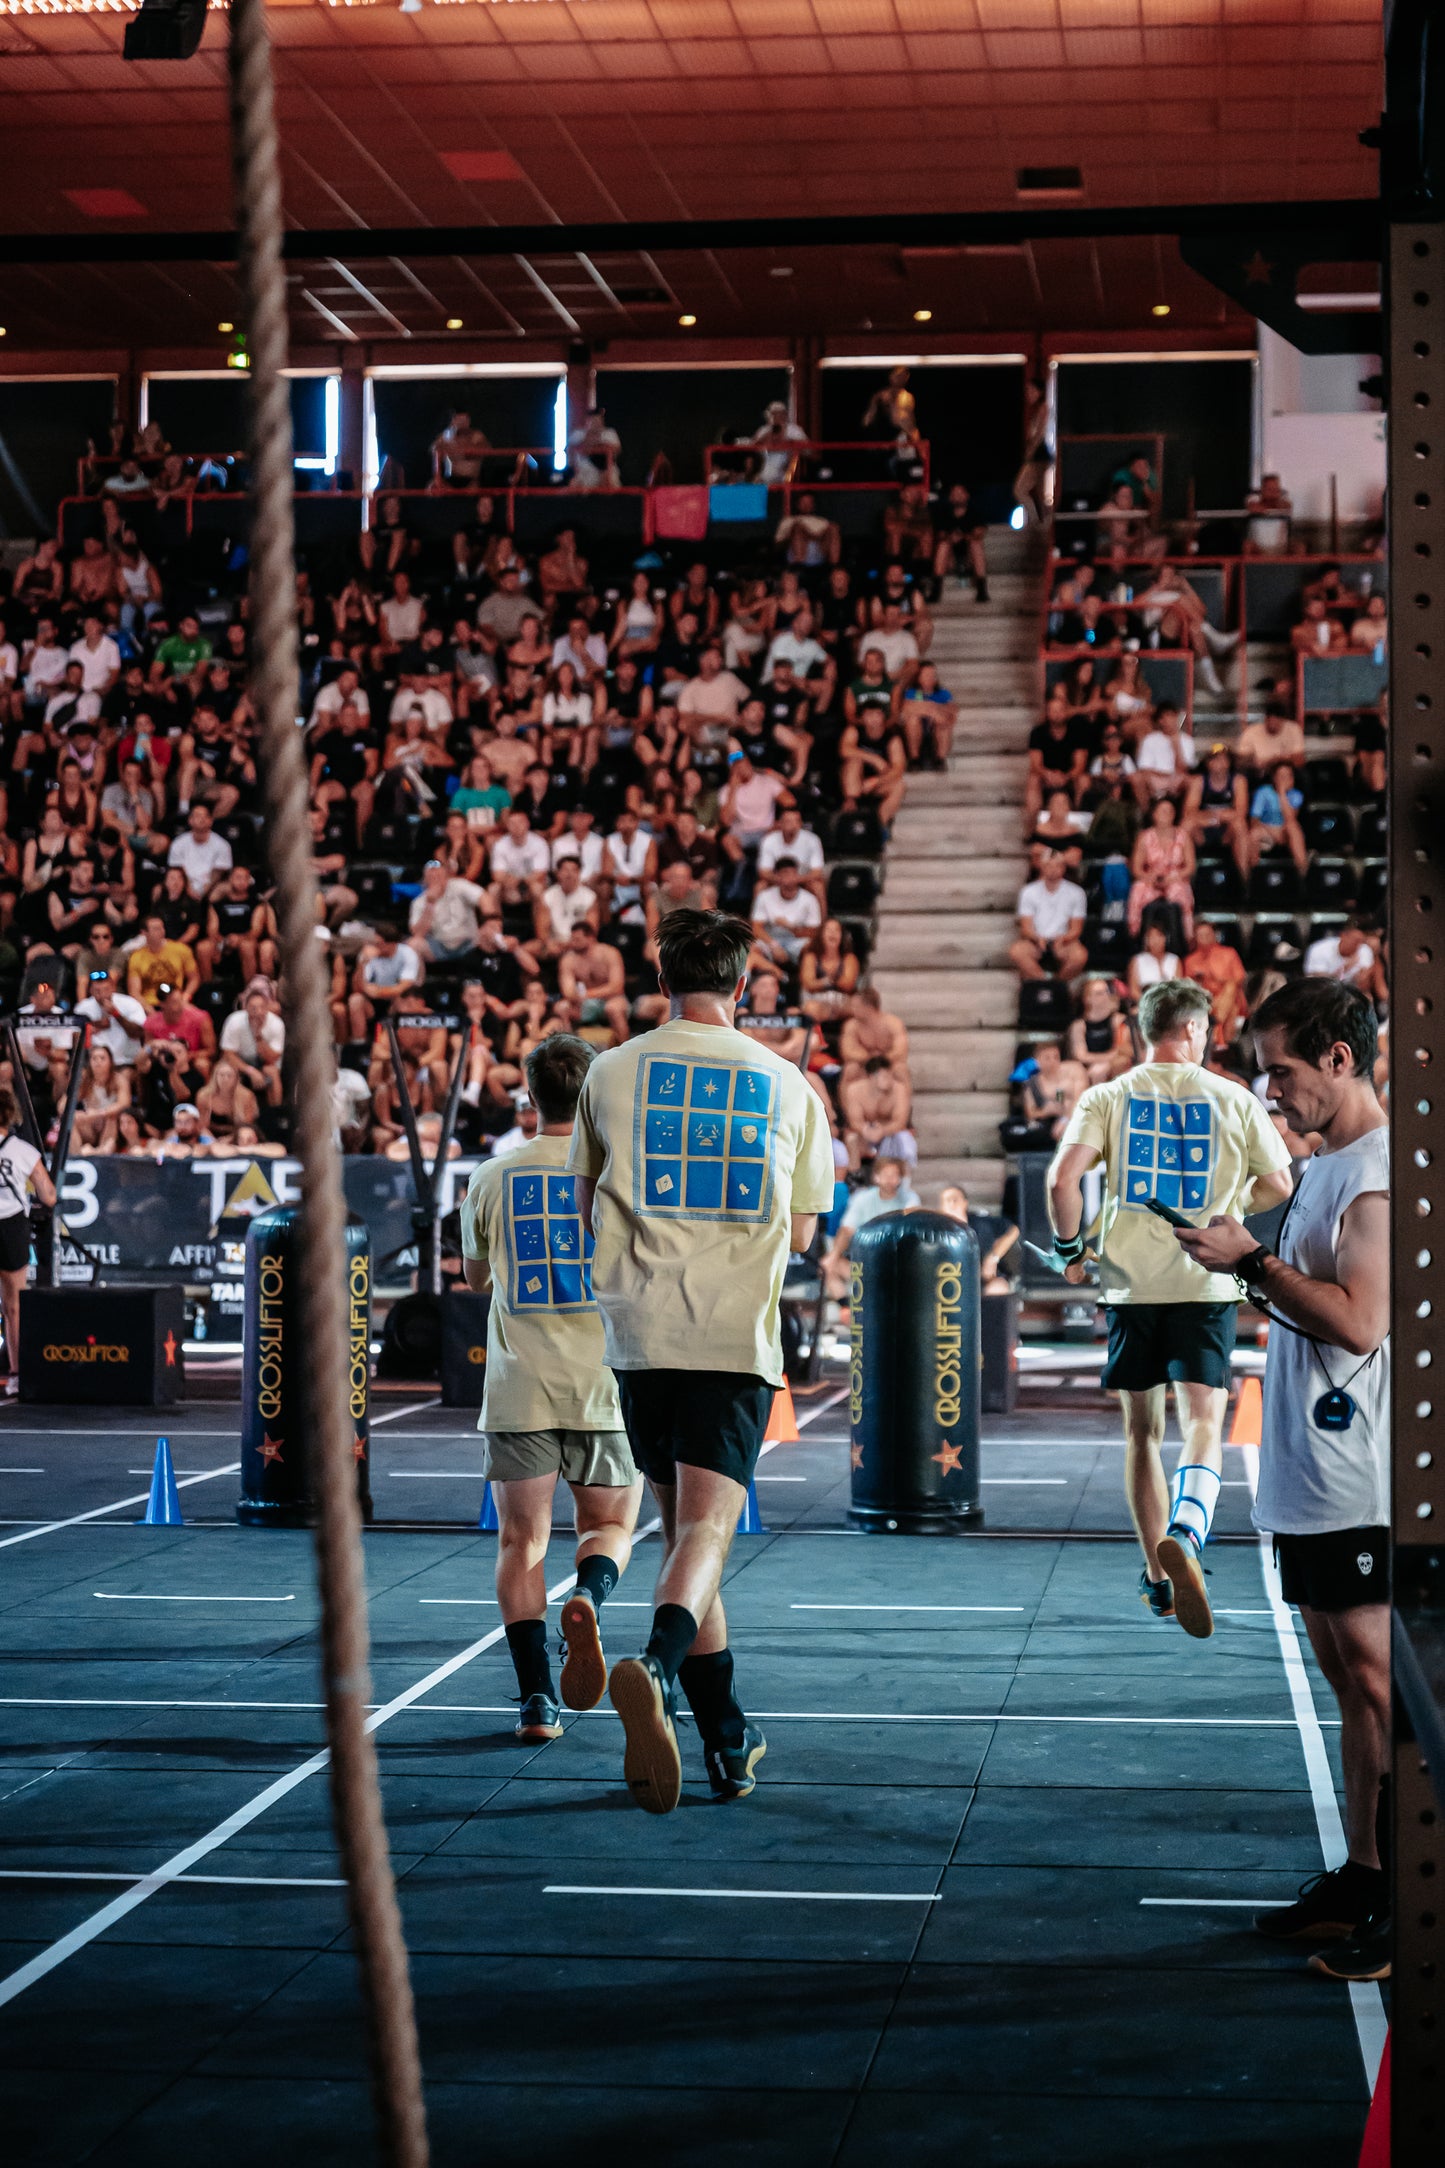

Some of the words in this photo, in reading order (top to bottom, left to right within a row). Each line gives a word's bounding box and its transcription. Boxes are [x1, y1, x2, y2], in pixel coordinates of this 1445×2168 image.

[258, 1255, 283, 1419] CROSSLIFTOR
[349, 1255, 369, 1419] CROSSLIFTOR
[934, 1261, 962, 1427] CROSSLIFTOR
